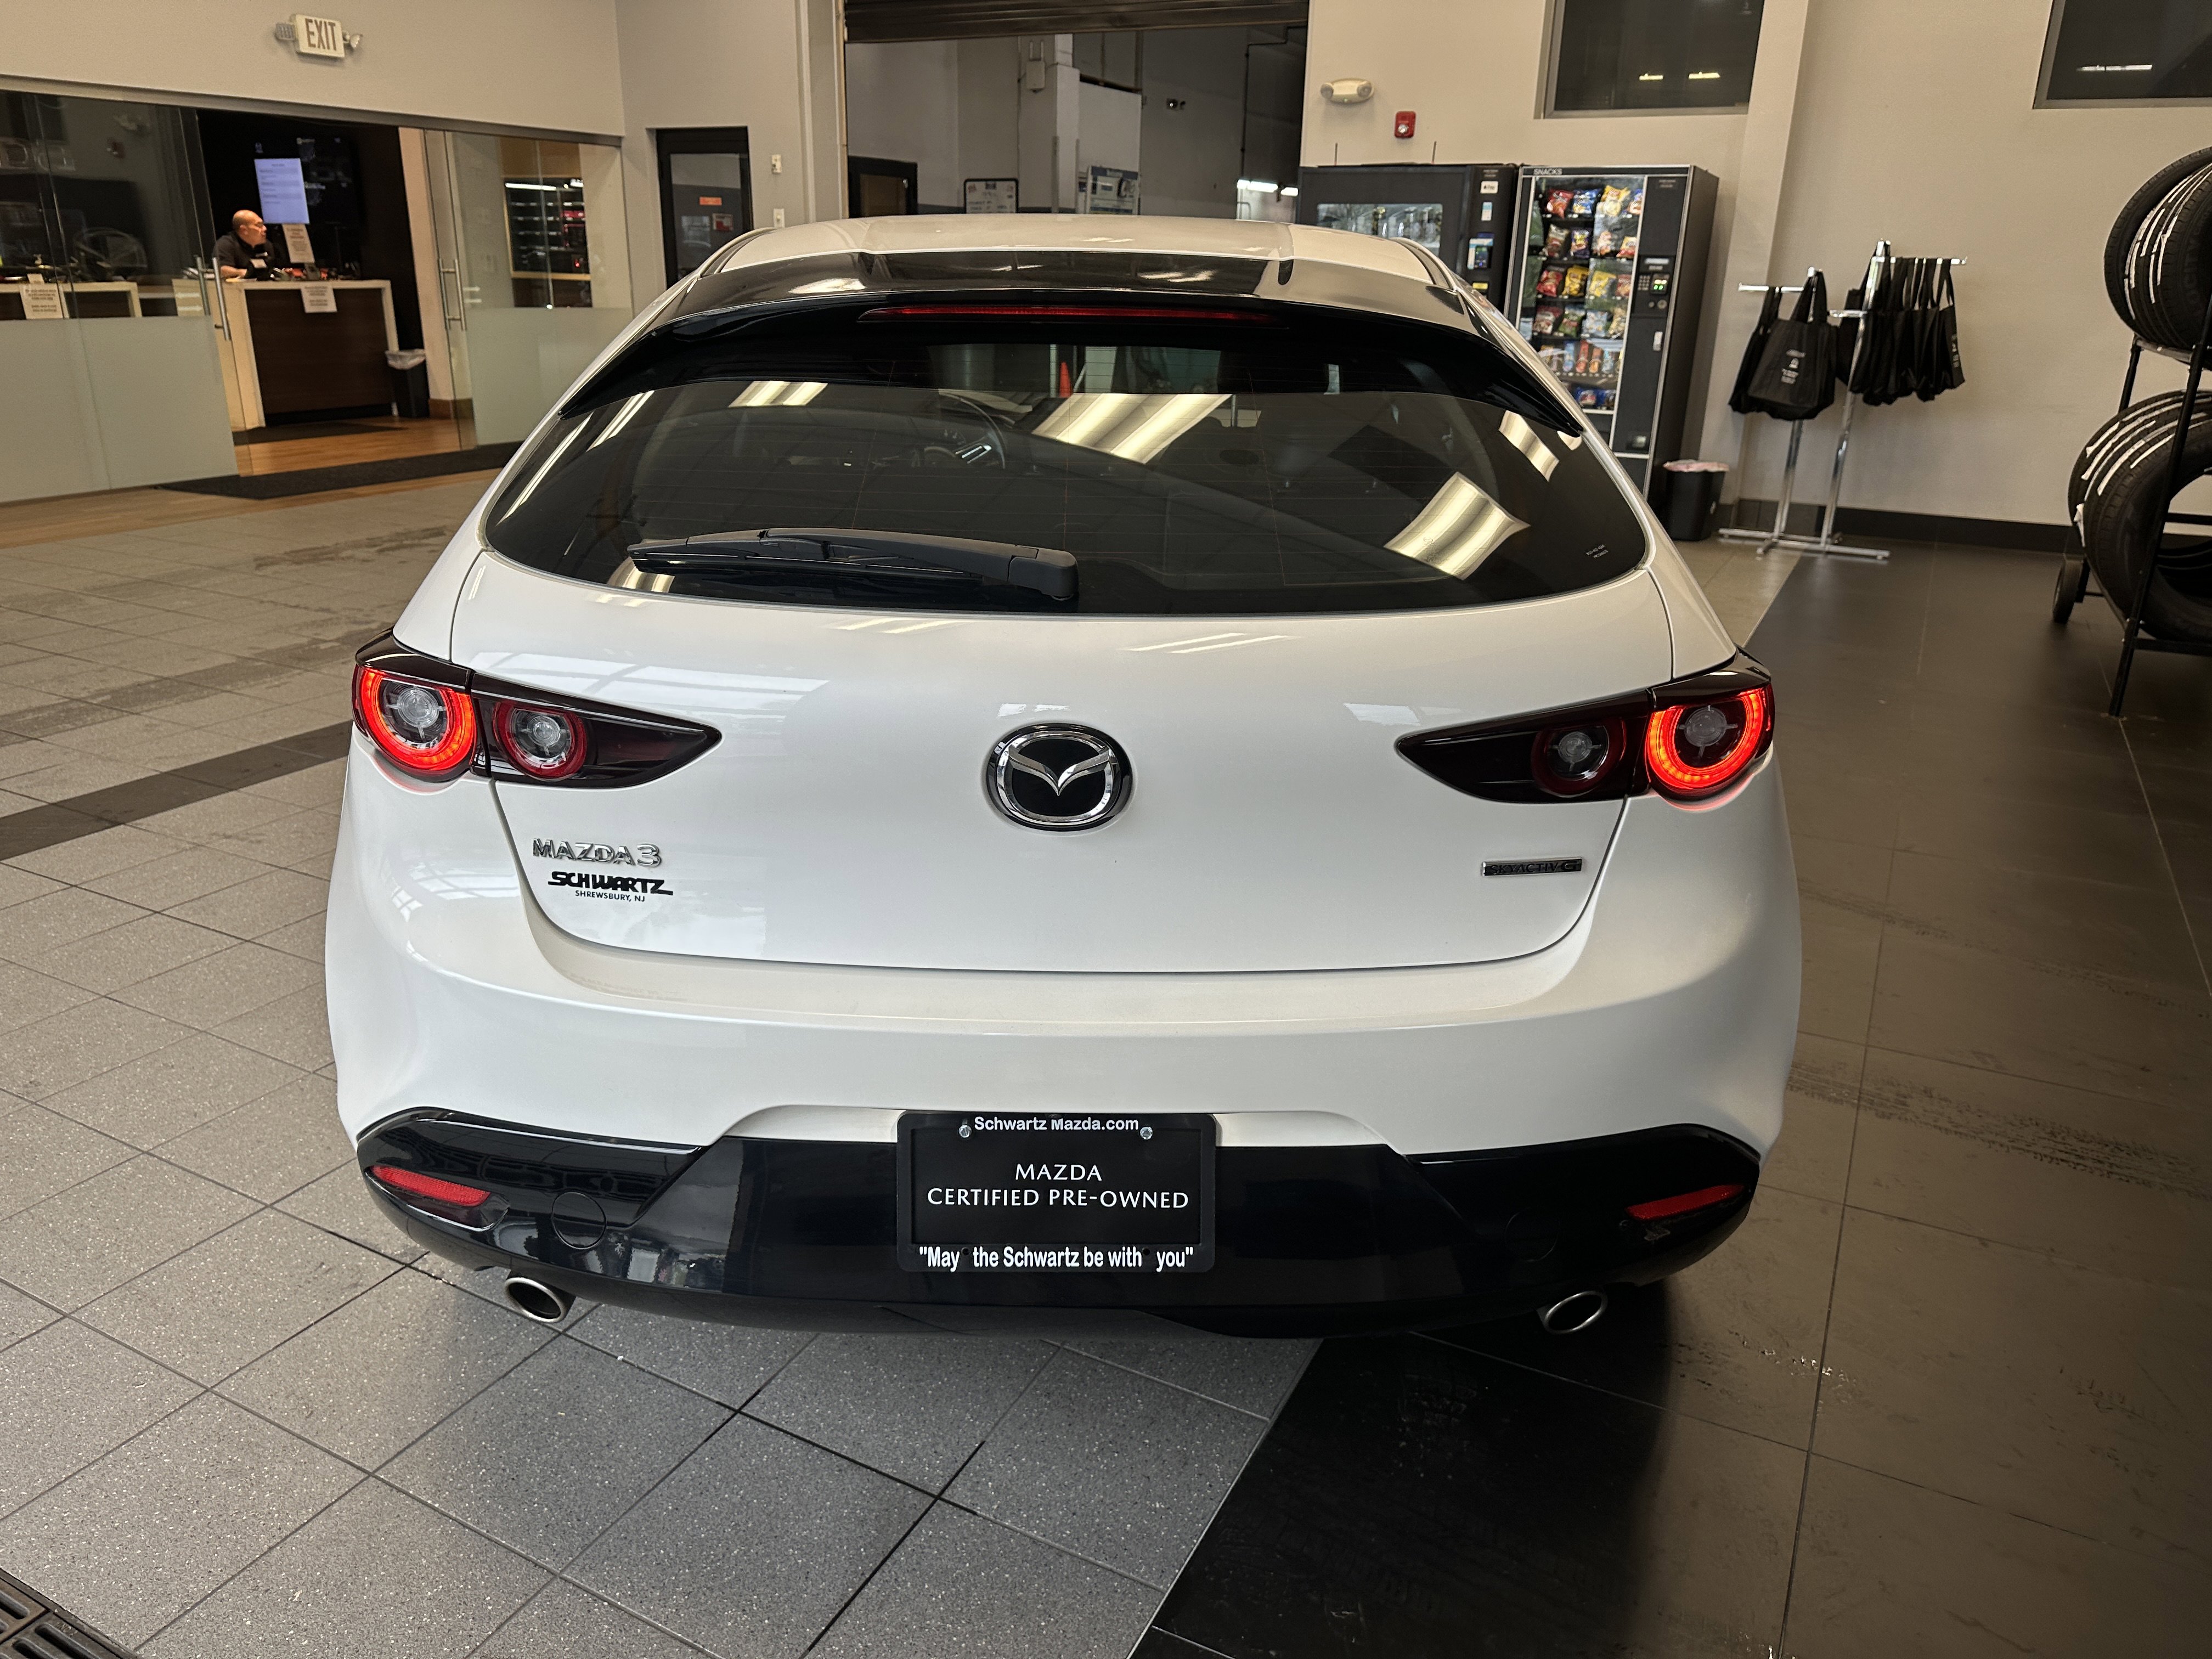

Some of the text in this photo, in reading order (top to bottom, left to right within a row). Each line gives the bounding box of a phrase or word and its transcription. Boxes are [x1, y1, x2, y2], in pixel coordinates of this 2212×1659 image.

[305, 18, 336, 51] EXIT
[533, 838, 662, 868] MAZDA3
[1489, 861, 1577, 875] SKYACTIV G
[548, 871, 673, 895] SCHWARTZ
[575, 890, 631, 902] SHREWSBURY,
[974, 1116, 1139, 1130] Schwartz Mazda.com
[1015, 1164, 1102, 1181] MAZDA
[927, 1188, 1189, 1208] CERTIFIED PRE-OWNED
[919, 1246, 1194, 1272] "May the Schwartz be with you"
